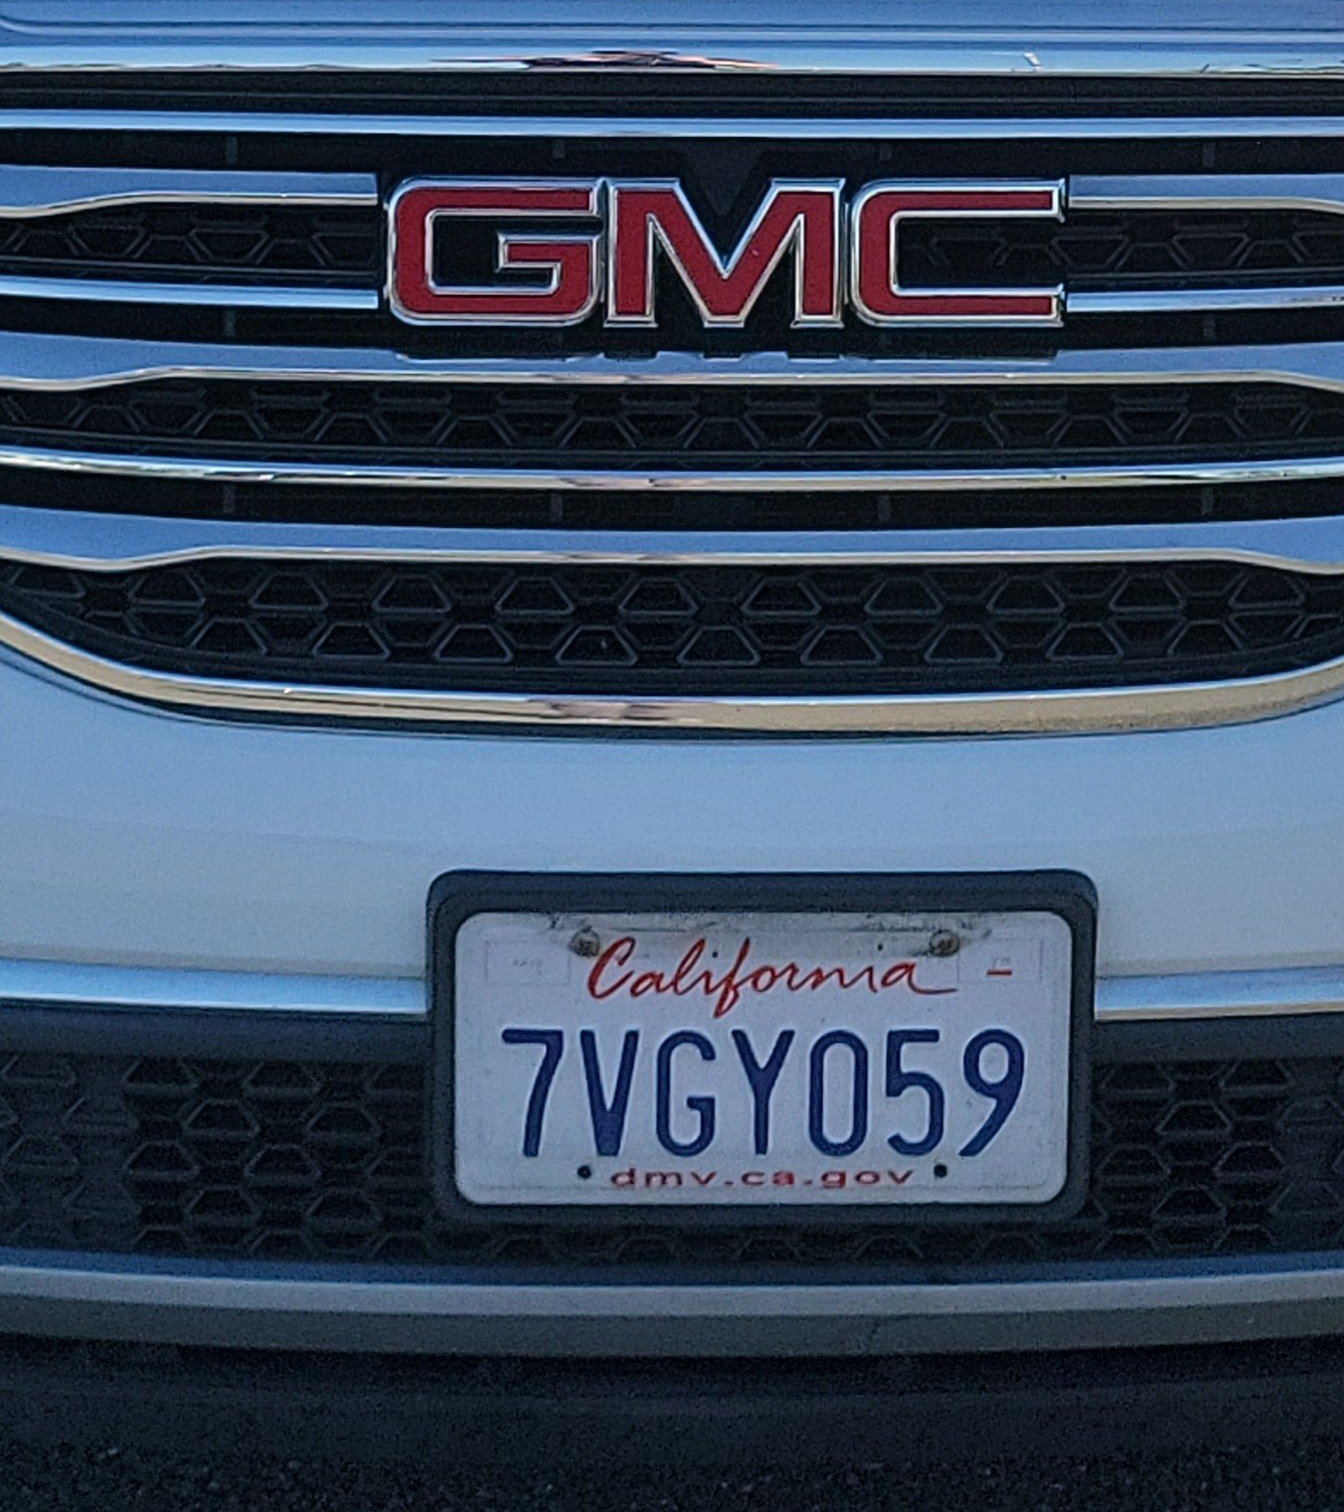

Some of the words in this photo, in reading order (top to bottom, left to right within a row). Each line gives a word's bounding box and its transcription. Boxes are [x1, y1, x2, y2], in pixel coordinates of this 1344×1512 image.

[387, 177, 1065, 328] GMC
[587, 935, 956, 1018] California
[501, 1029, 1026, 1157] 7VGY059
[609, 1166, 915, 1188] dmv.ca.gov
